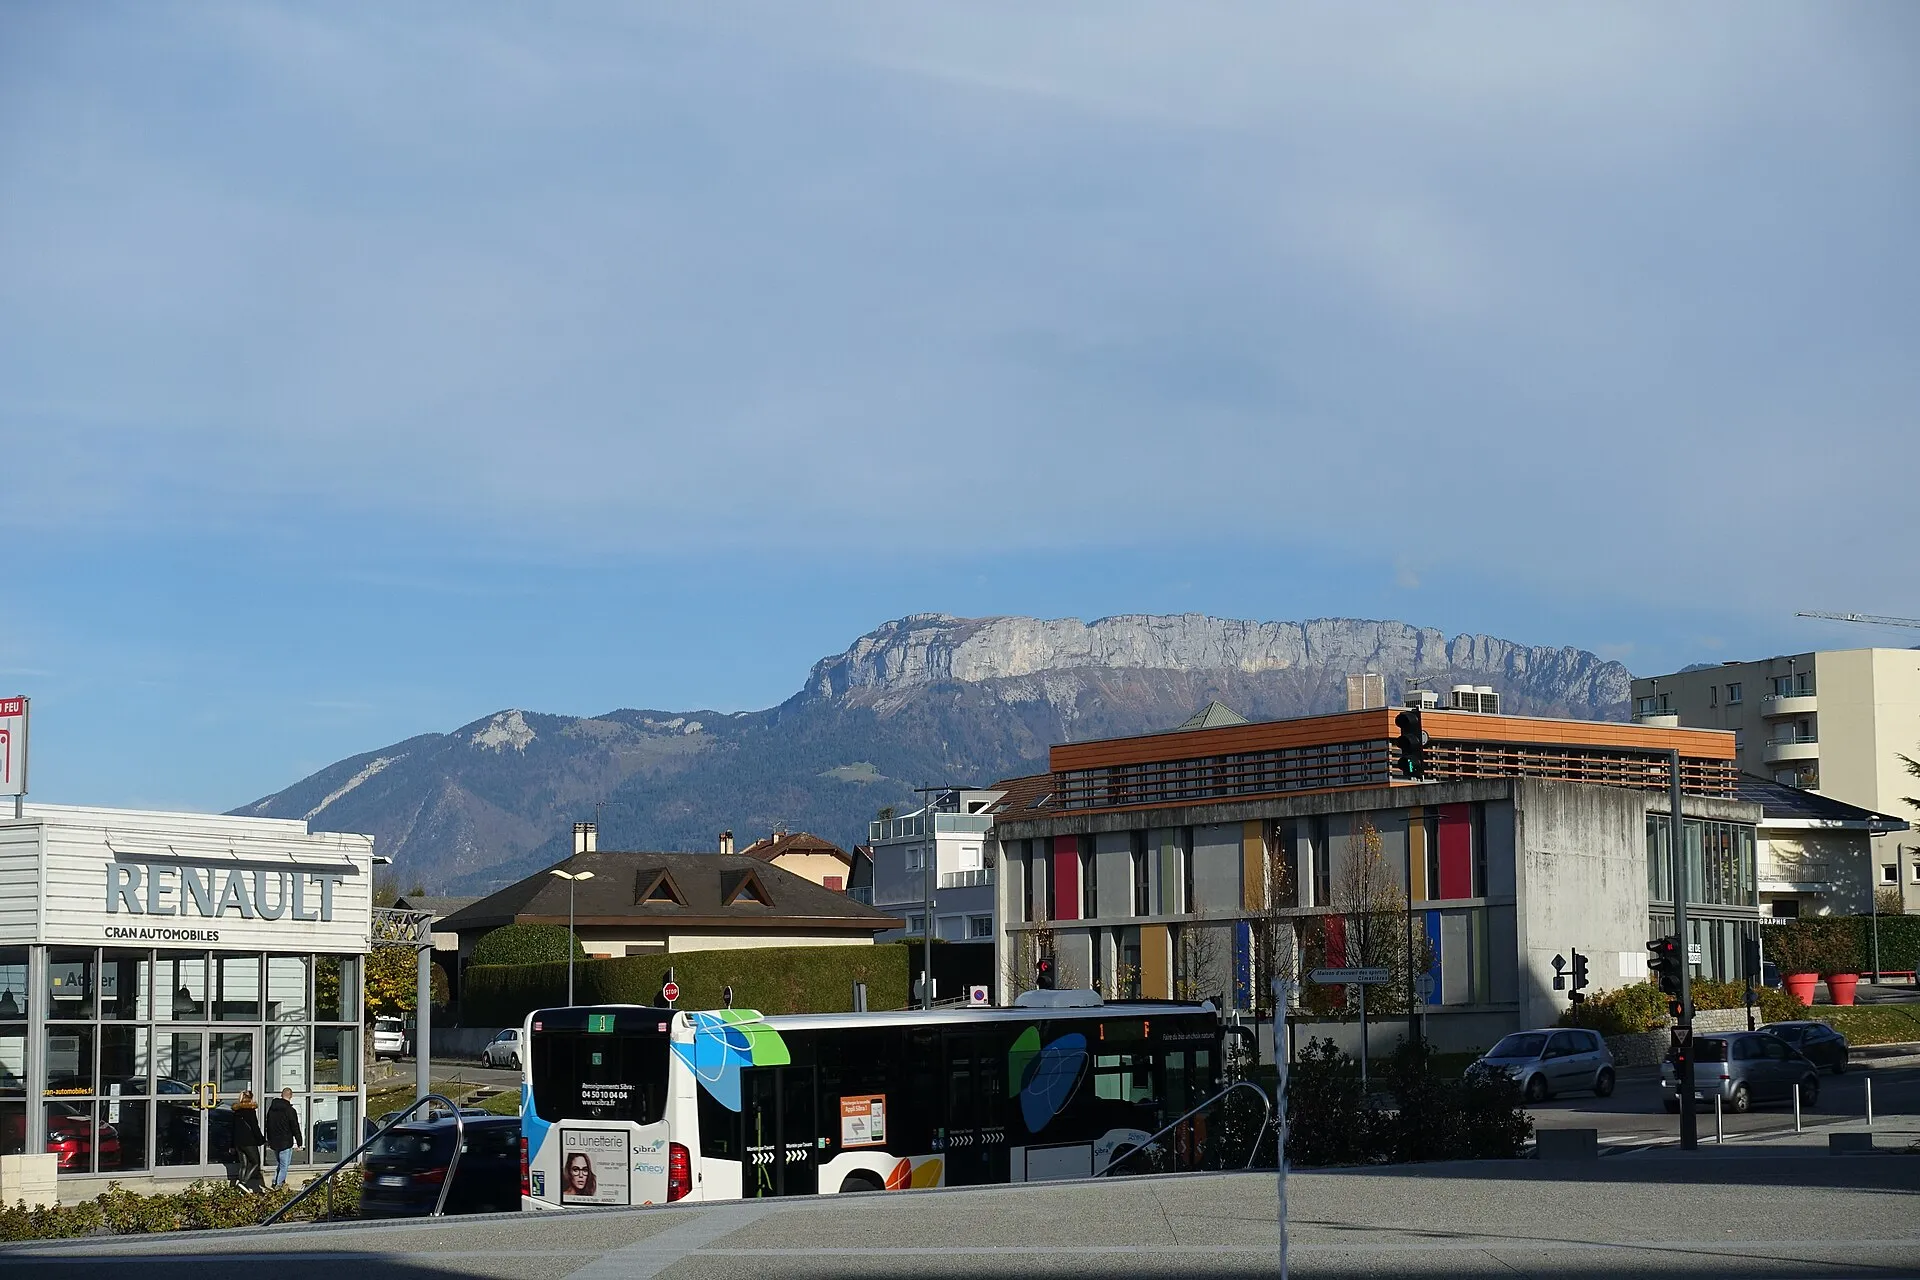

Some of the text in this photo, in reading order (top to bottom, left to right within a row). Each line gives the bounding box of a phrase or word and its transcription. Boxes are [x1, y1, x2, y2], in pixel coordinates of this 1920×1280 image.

[5, 702, 19, 712] FEU
[105, 862, 343, 922] RENAULT
[104, 926, 219, 941] CRAN AUTOMOBILES
[65, 971, 115, 987] Ater
[600, 1015, 606, 1031] 1
[566, 1132, 622, 1148] La Lunetterie
[633, 1145, 656, 1154] Sibra
[634, 1162, 664, 1174] Annecy
